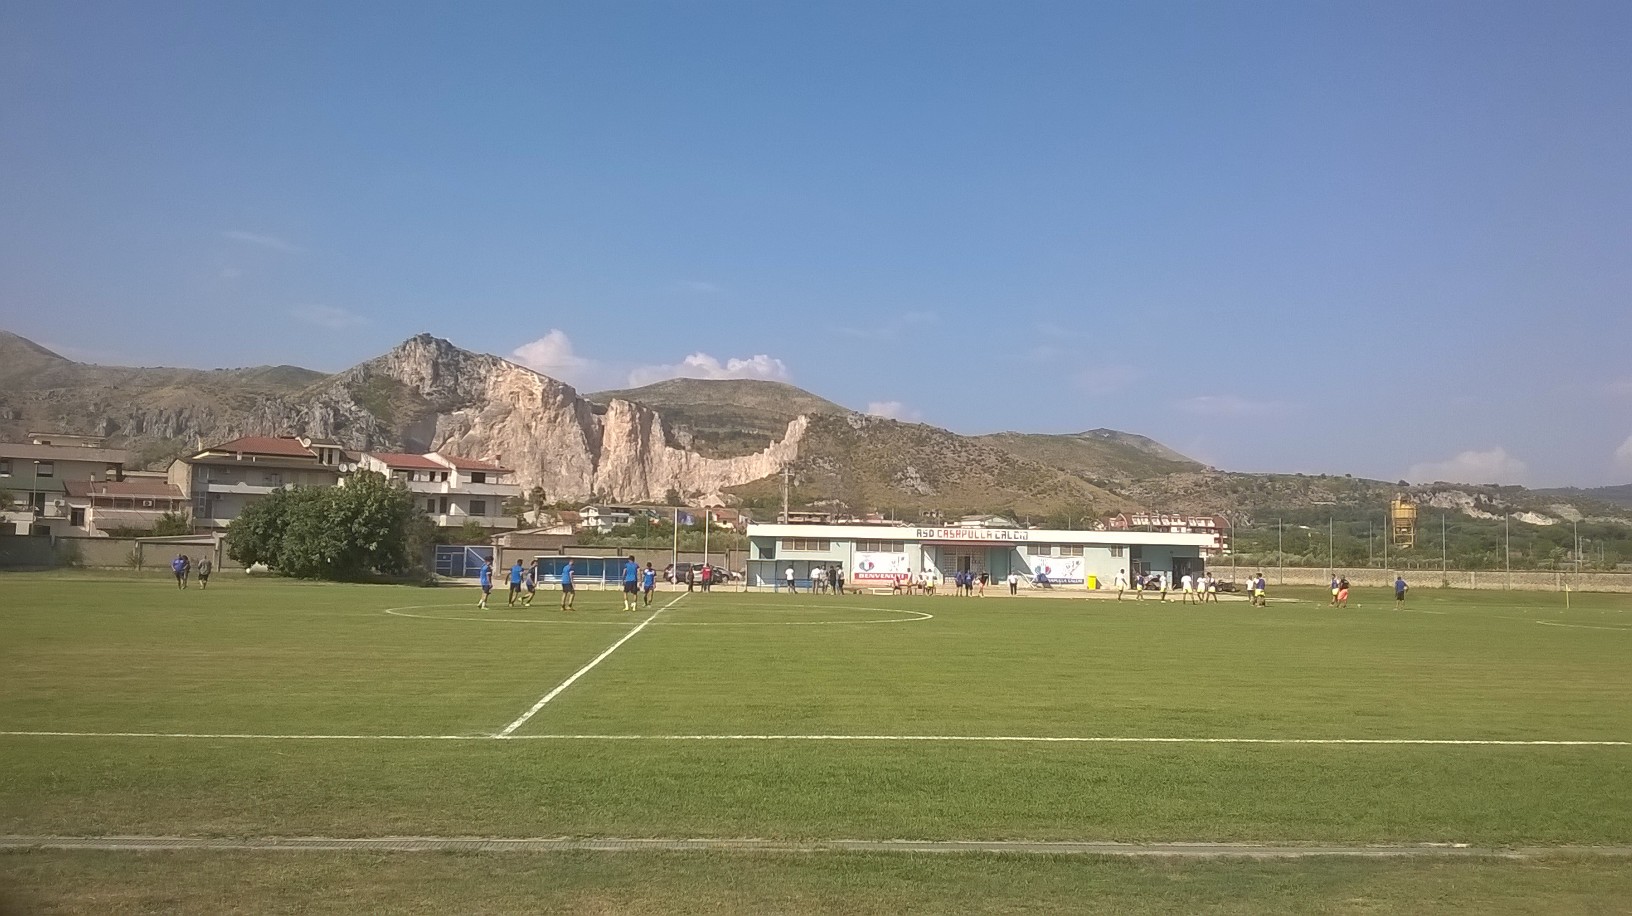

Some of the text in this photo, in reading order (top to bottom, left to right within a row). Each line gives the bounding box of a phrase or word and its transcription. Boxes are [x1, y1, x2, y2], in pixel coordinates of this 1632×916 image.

[916, 529, 1029, 540] ASD CASAPULLA CALCIO
